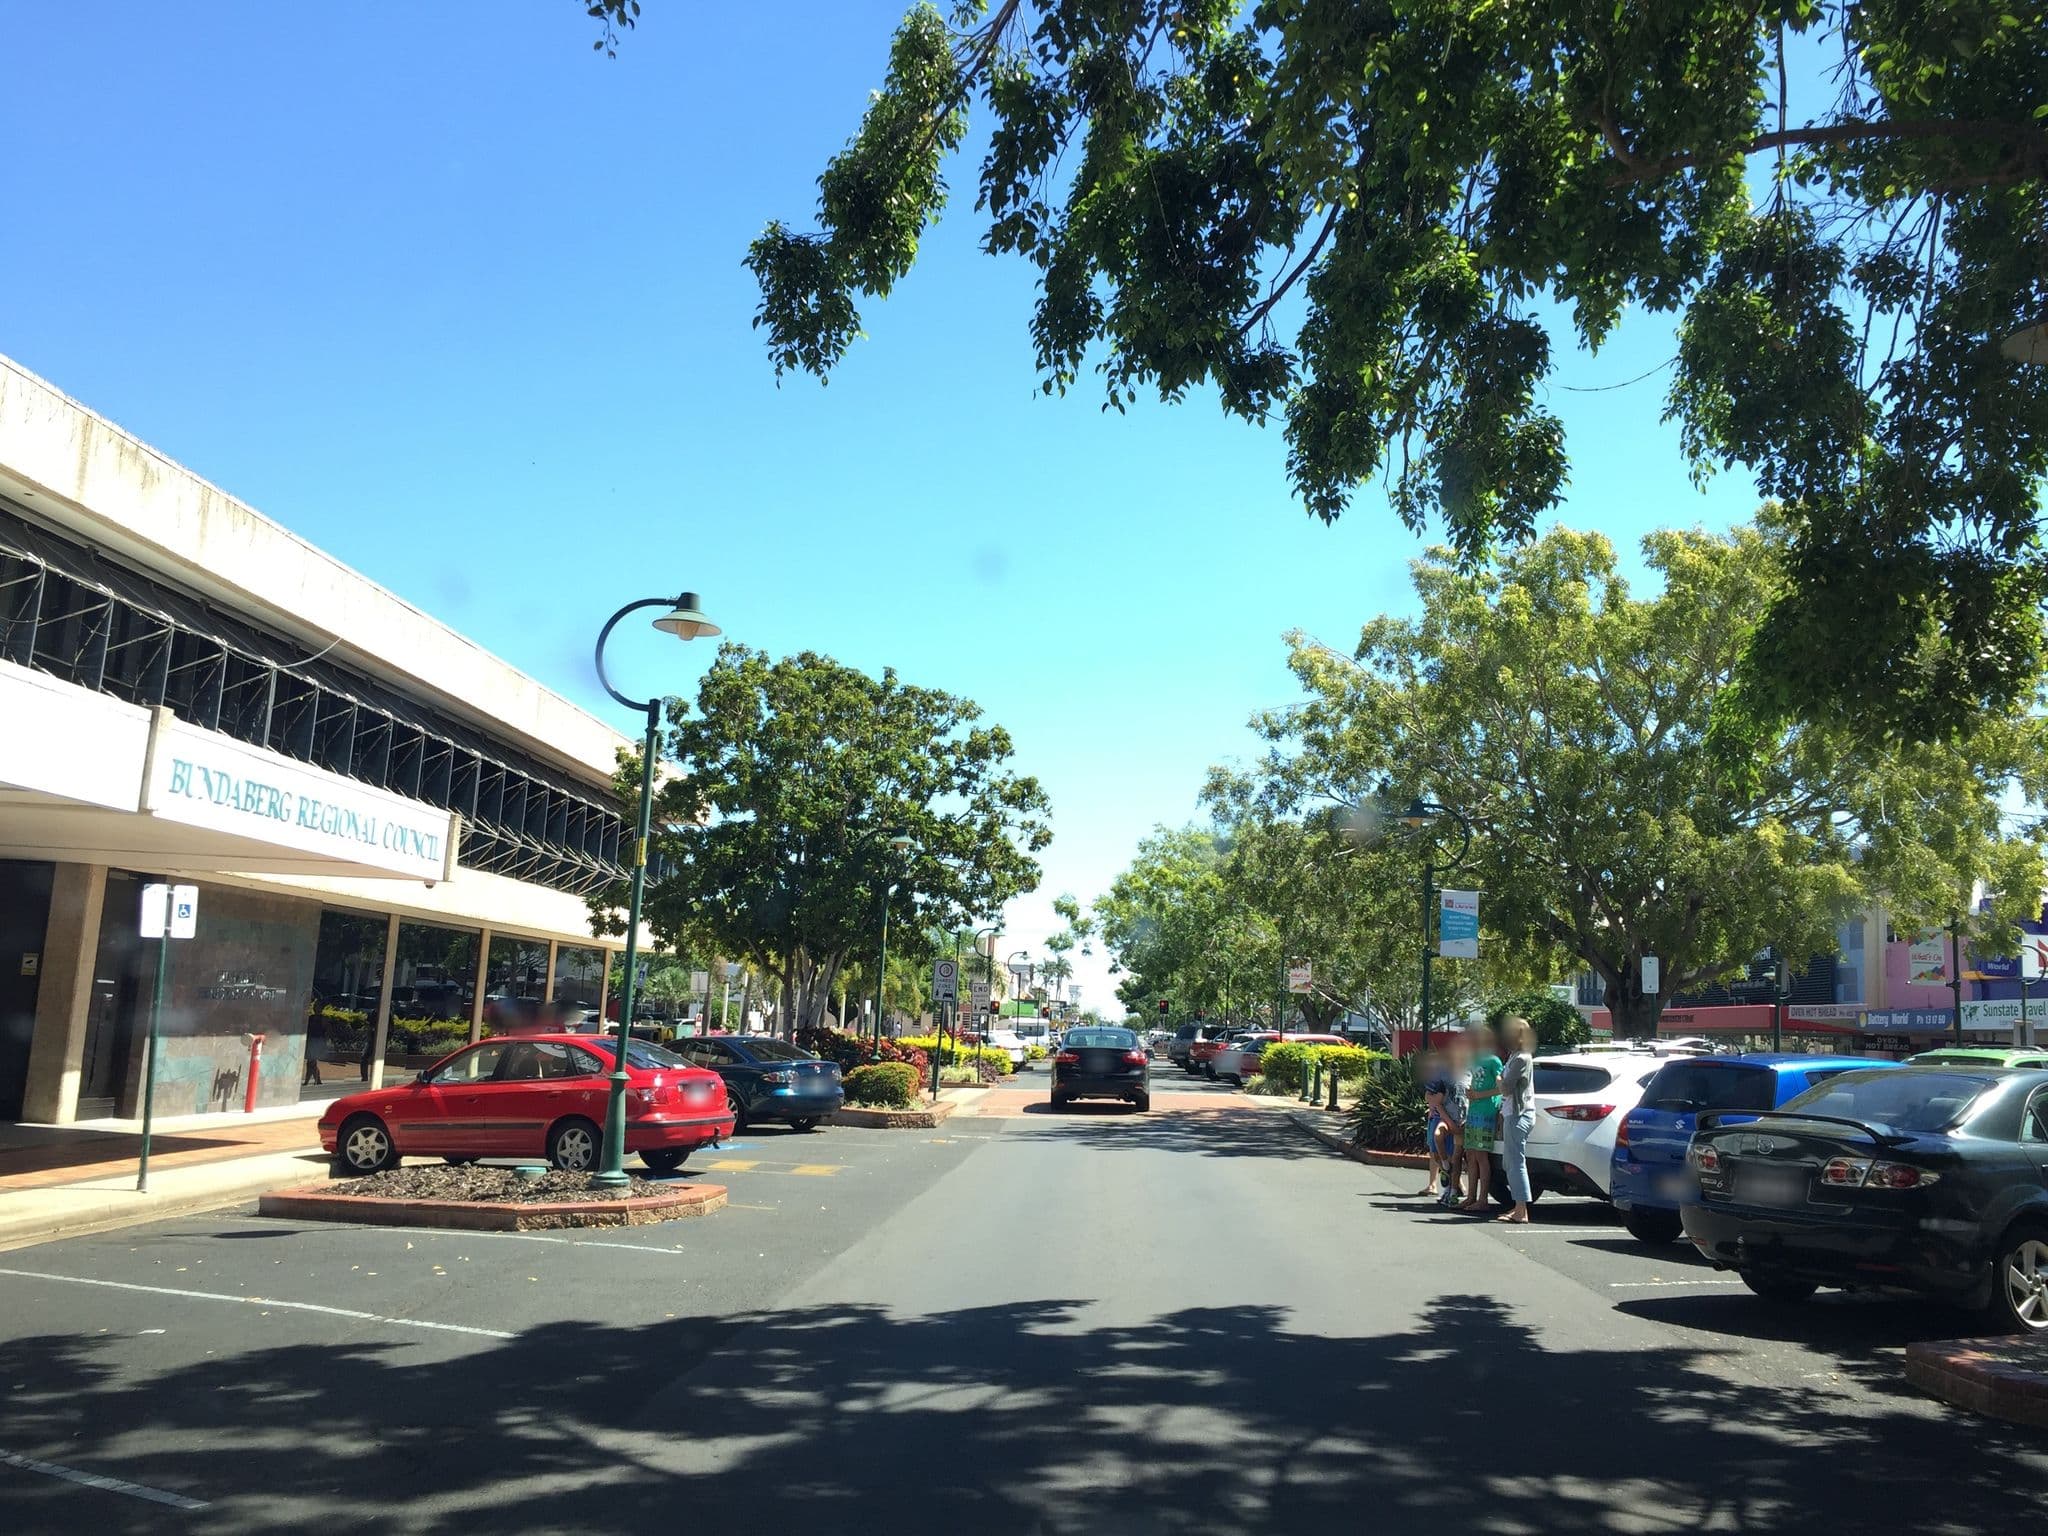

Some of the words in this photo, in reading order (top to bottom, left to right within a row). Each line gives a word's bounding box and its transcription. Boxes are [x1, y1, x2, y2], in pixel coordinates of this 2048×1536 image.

[168, 758, 292, 823] BUNDABERG
[296, 795, 378, 846] REGIONAL
[382, 821, 440, 862] COUNCIL
[1987, 962, 2010, 971] World
[1983, 1003, 2019, 1017] Sunstate
[2020, 1001, 2047, 1016] avel
[1868, 1013, 1889, 1027] Battery
[1891, 1013, 1909, 1025] World
